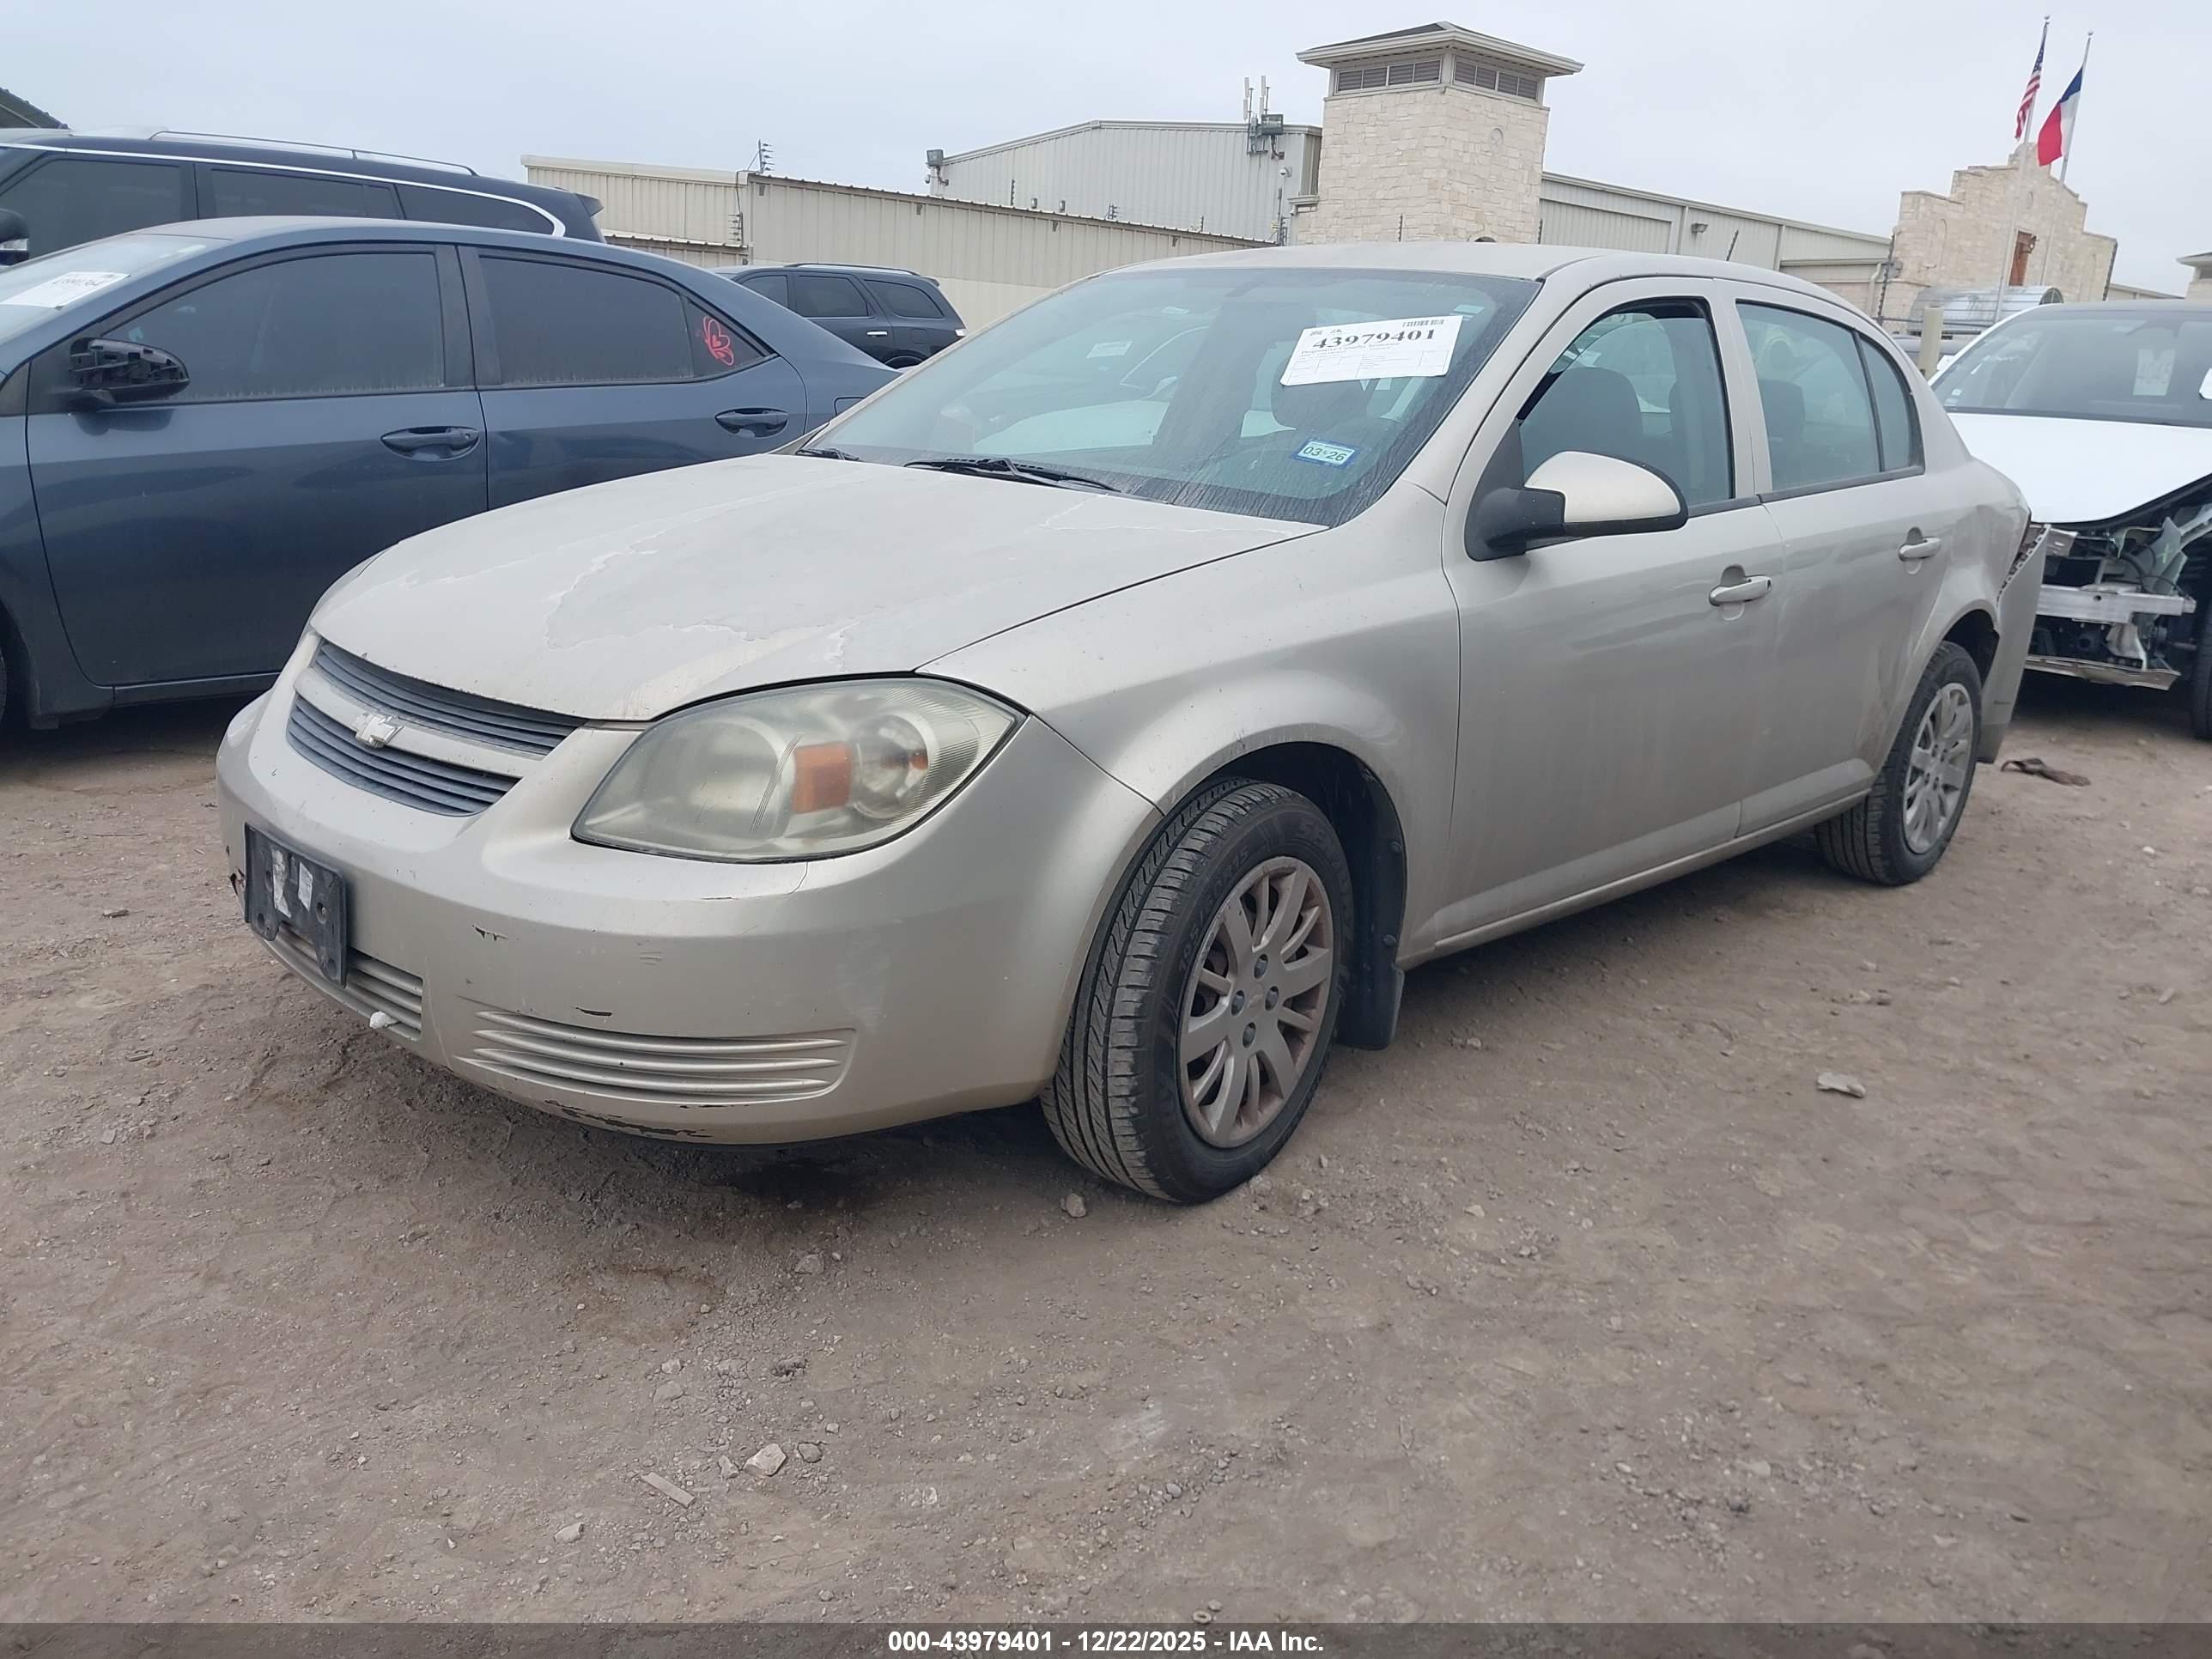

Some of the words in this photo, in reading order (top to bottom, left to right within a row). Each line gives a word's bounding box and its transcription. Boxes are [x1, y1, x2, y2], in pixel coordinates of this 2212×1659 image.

[1312, 328, 1436, 349] 43979401
[1303, 446, 1322, 456] 03
[1325, 451, 1347, 462] 26
